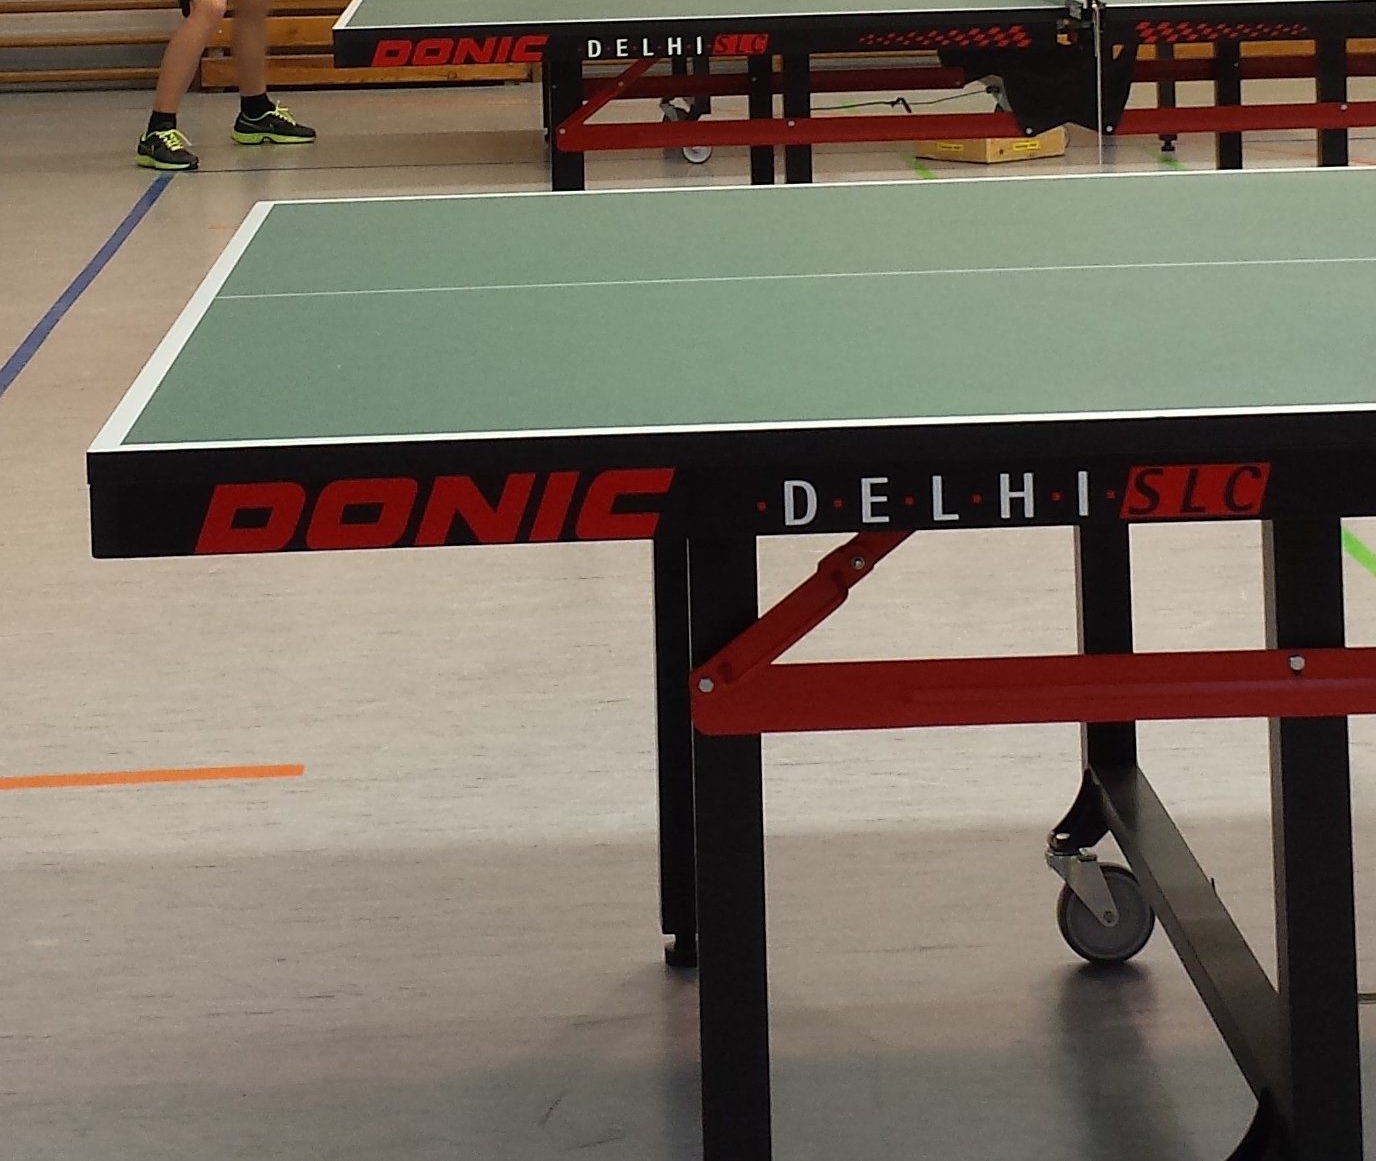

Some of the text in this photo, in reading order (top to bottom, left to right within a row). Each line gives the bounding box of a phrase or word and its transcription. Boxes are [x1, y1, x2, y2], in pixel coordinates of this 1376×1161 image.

[371, 34, 549, 67] DONIC
[194, 467, 676, 554] DONIC
[1127, 466, 1263, 516] SLC
